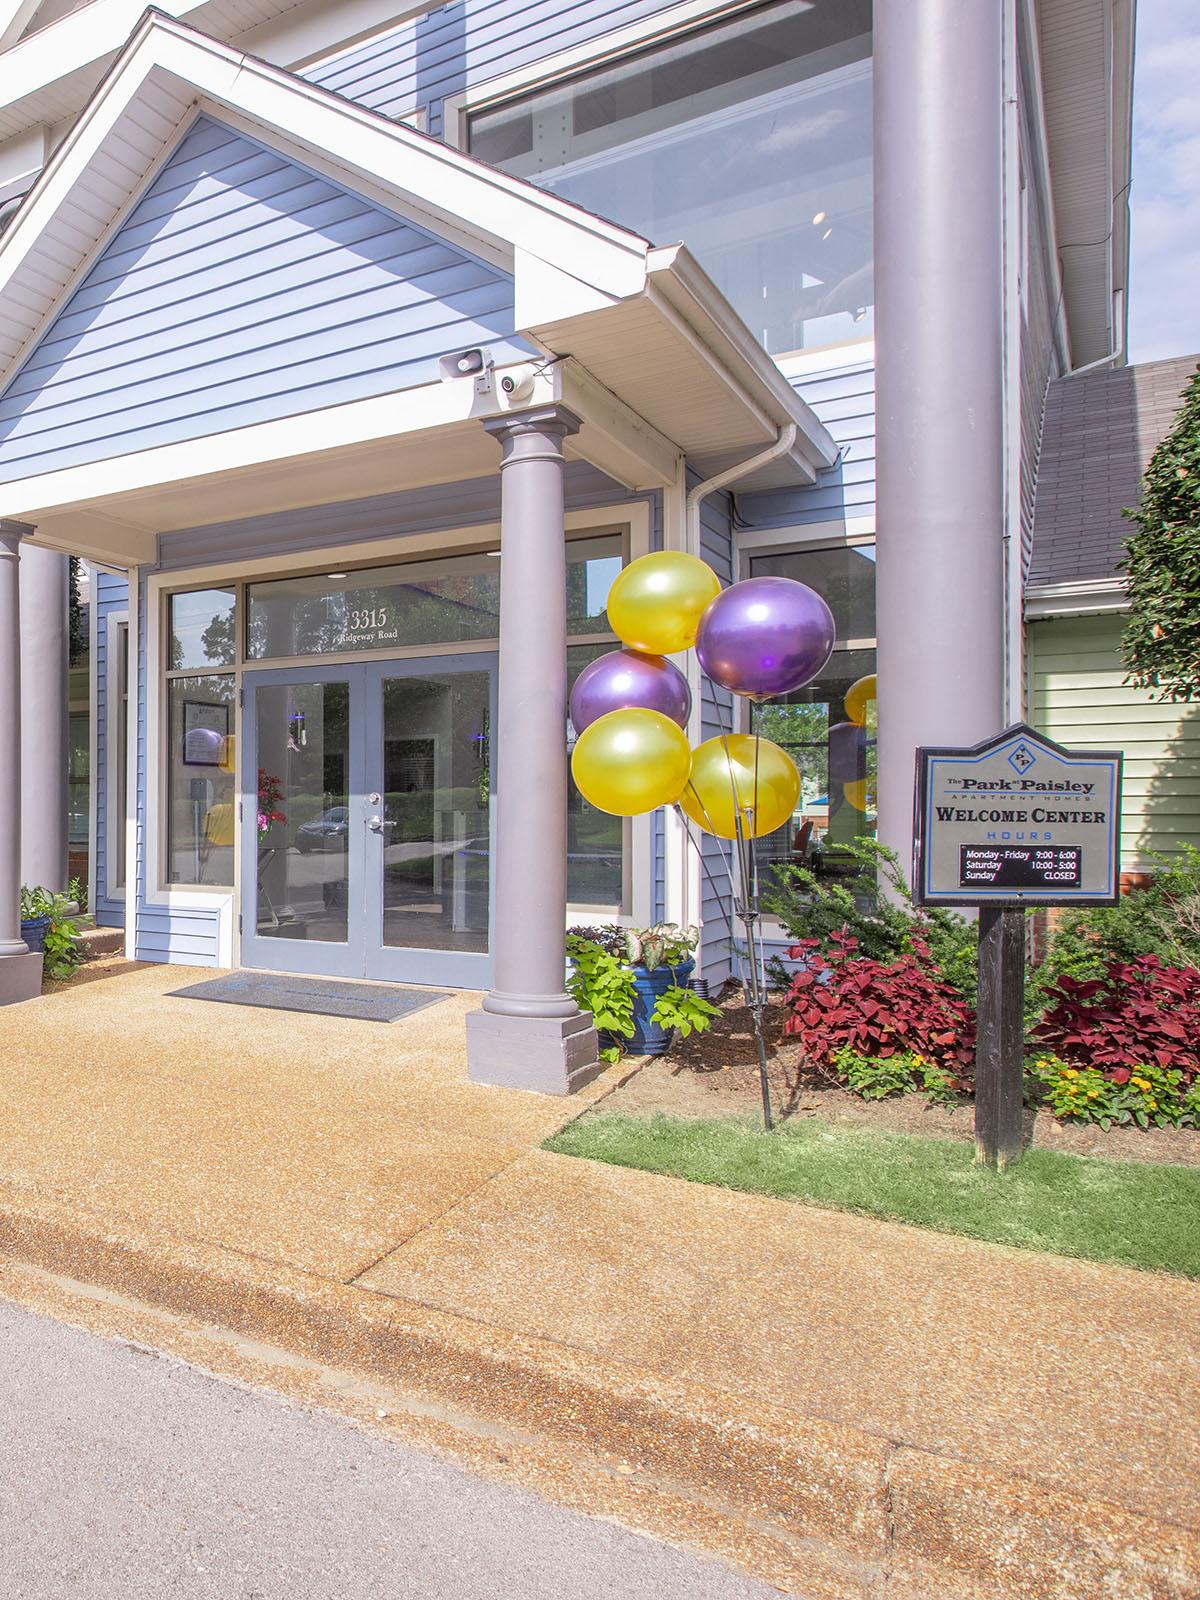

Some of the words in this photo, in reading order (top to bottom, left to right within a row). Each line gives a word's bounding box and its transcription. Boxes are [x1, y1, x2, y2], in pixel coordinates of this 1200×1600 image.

[350, 607, 387, 630] 3315
[340, 632, 376, 644] Ridgeway
[378, 628, 398, 639] Road
[962, 779, 1012, 790] Park
[1020, 780, 1095, 794] Paisley
[936, 807, 1028, 823] WELCOME
[1031, 808, 1106, 824] CENTER
[987, 831, 1052, 840] HOURS
[966, 850, 999, 860] Monday
[1004, 850, 1030, 860] Friday
[1036, 851, 1053, 859] 9:00
[1059, 851, 1076, 859] 6:00
[966, 861, 1002, 871] Saturday
[1032, 861, 1053, 870] 10:00
[1059, 861, 1076, 870] 5:00
[966, 871, 996, 881] Sunday
[1044, 872, 1076, 880] CLOSED
